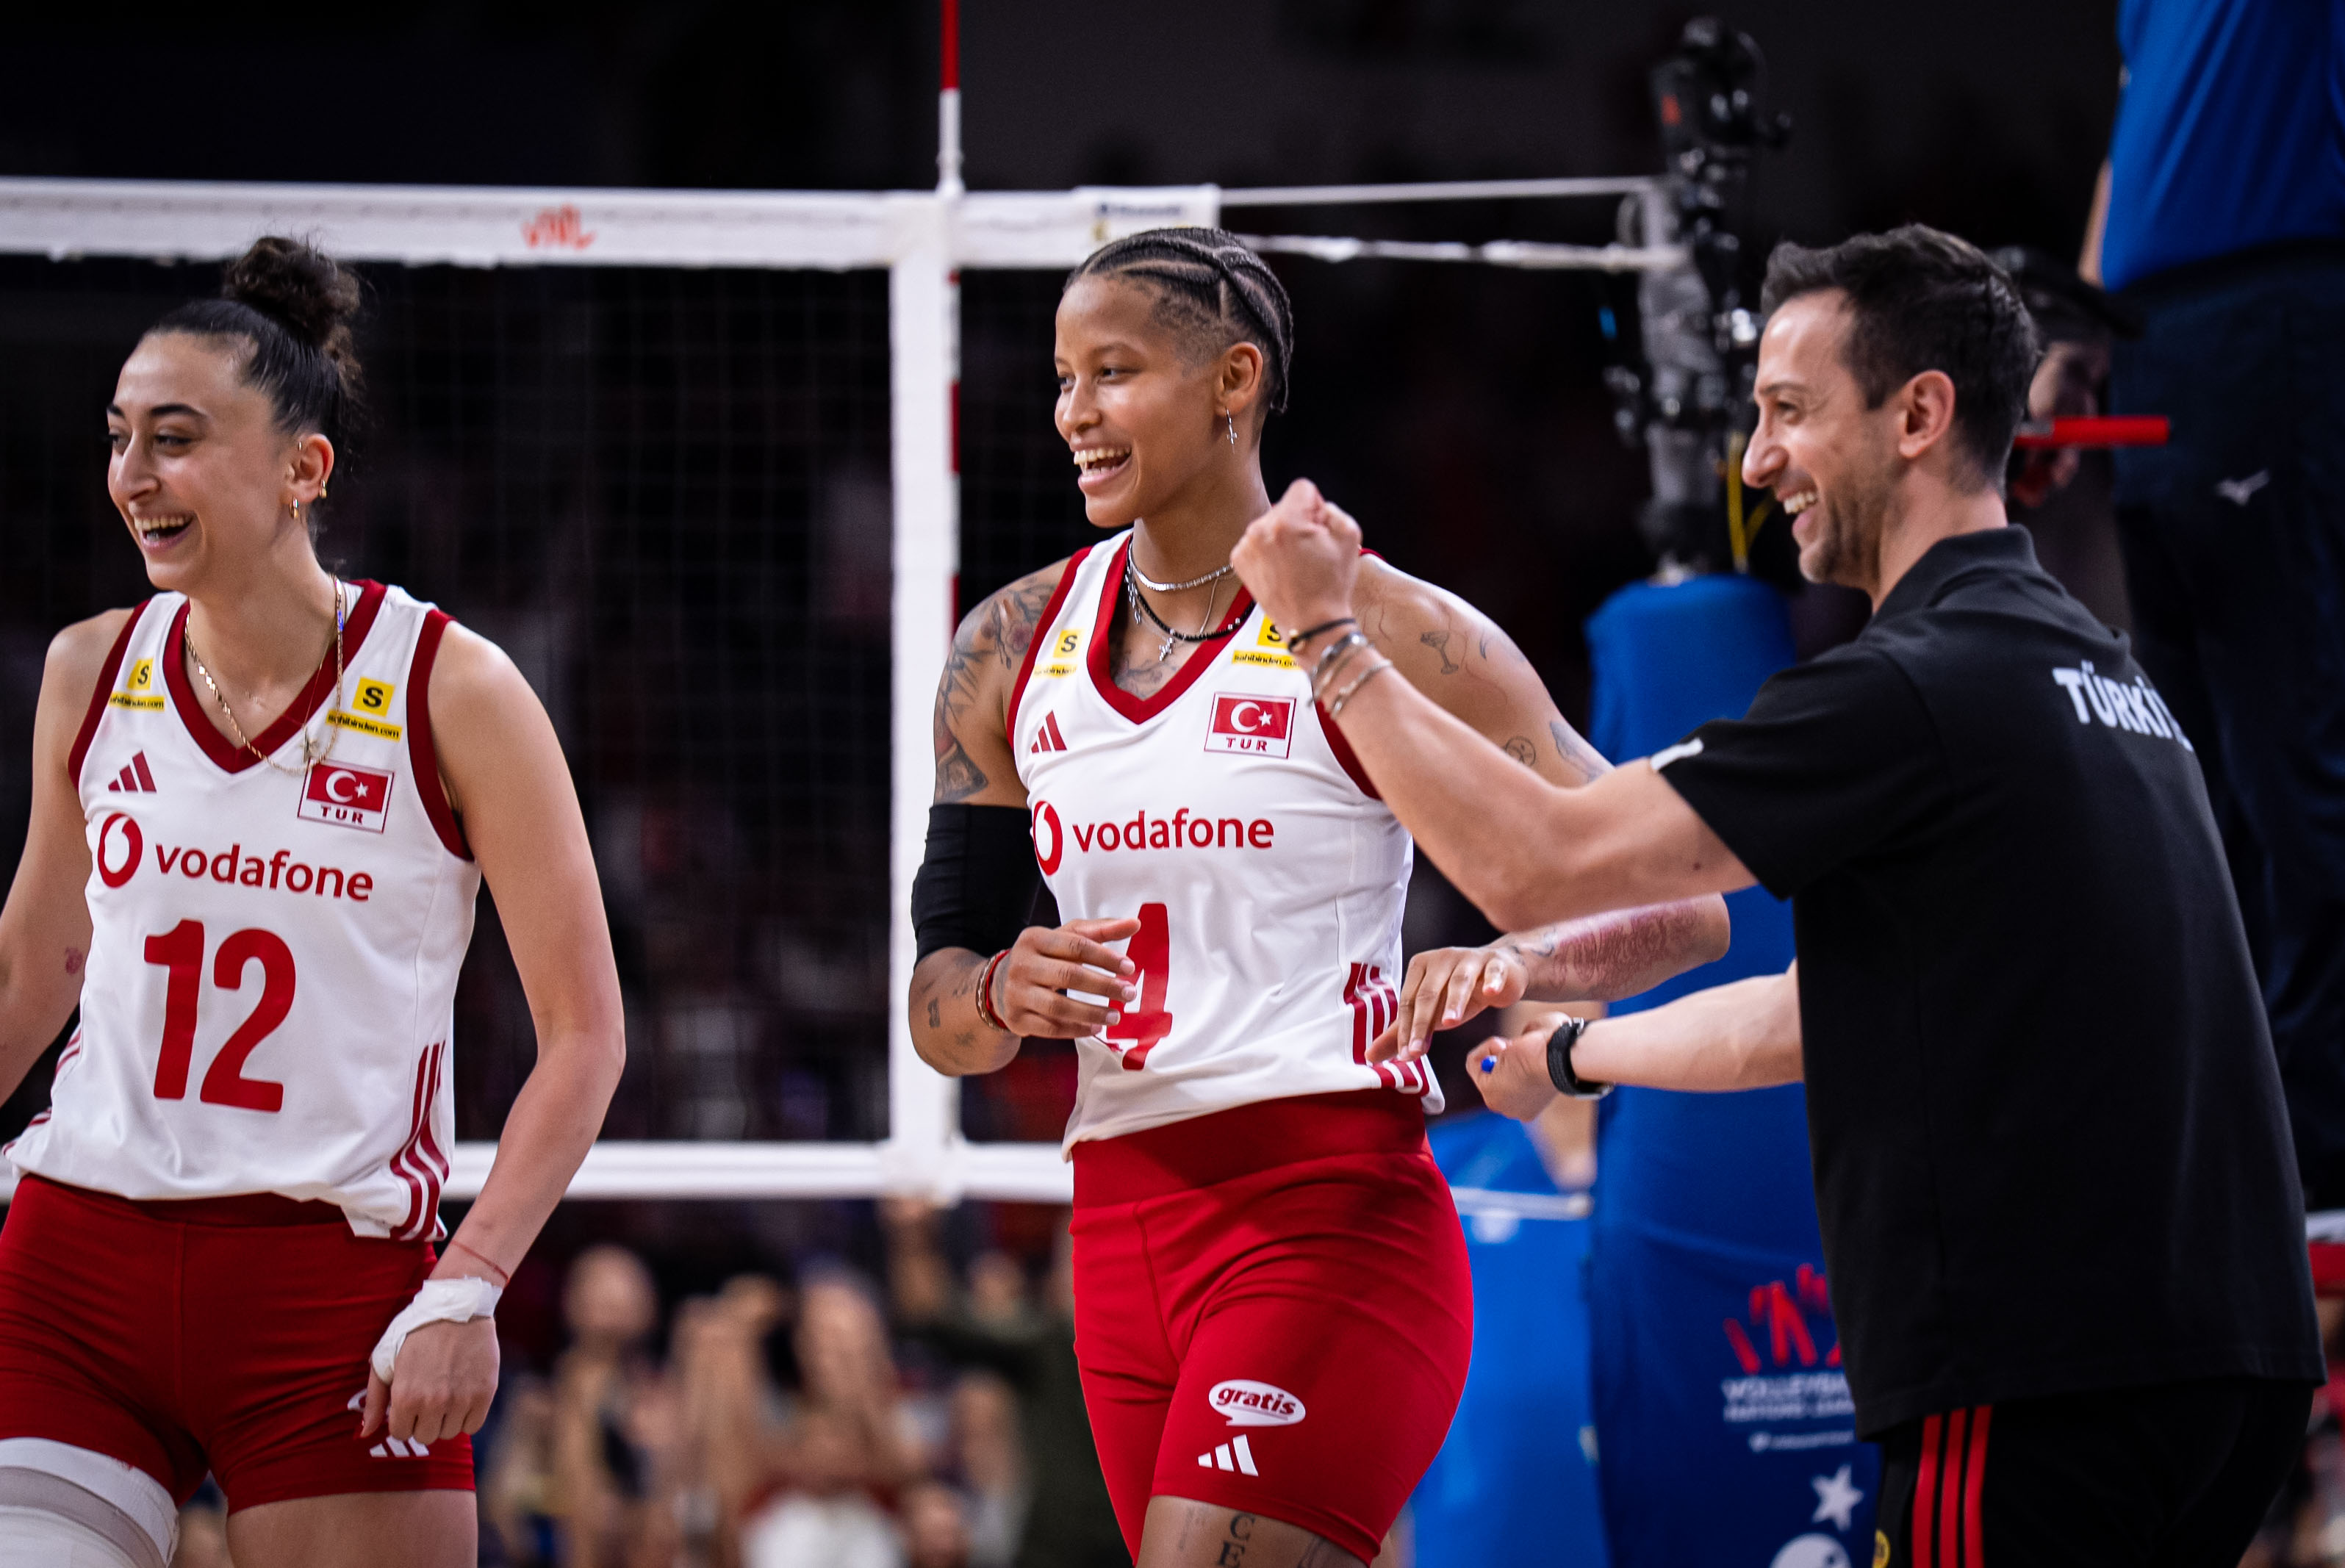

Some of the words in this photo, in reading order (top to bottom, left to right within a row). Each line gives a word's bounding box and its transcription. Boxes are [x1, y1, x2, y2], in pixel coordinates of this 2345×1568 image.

[1060, 634, 1078, 653] S
[137, 665, 150, 686] S
[362, 686, 384, 709] S
[2052, 659, 2194, 753] TÜRKİ
[1226, 736, 1268, 752] TUR
[322, 807, 364, 824] TUR
[1072, 807, 1275, 853] vodafone
[155, 843, 374, 902] vodafone
[1104, 902, 1174, 1071] 4
[143, 918, 297, 1113] 12
[1216, 1387, 1296, 1415] gratis
